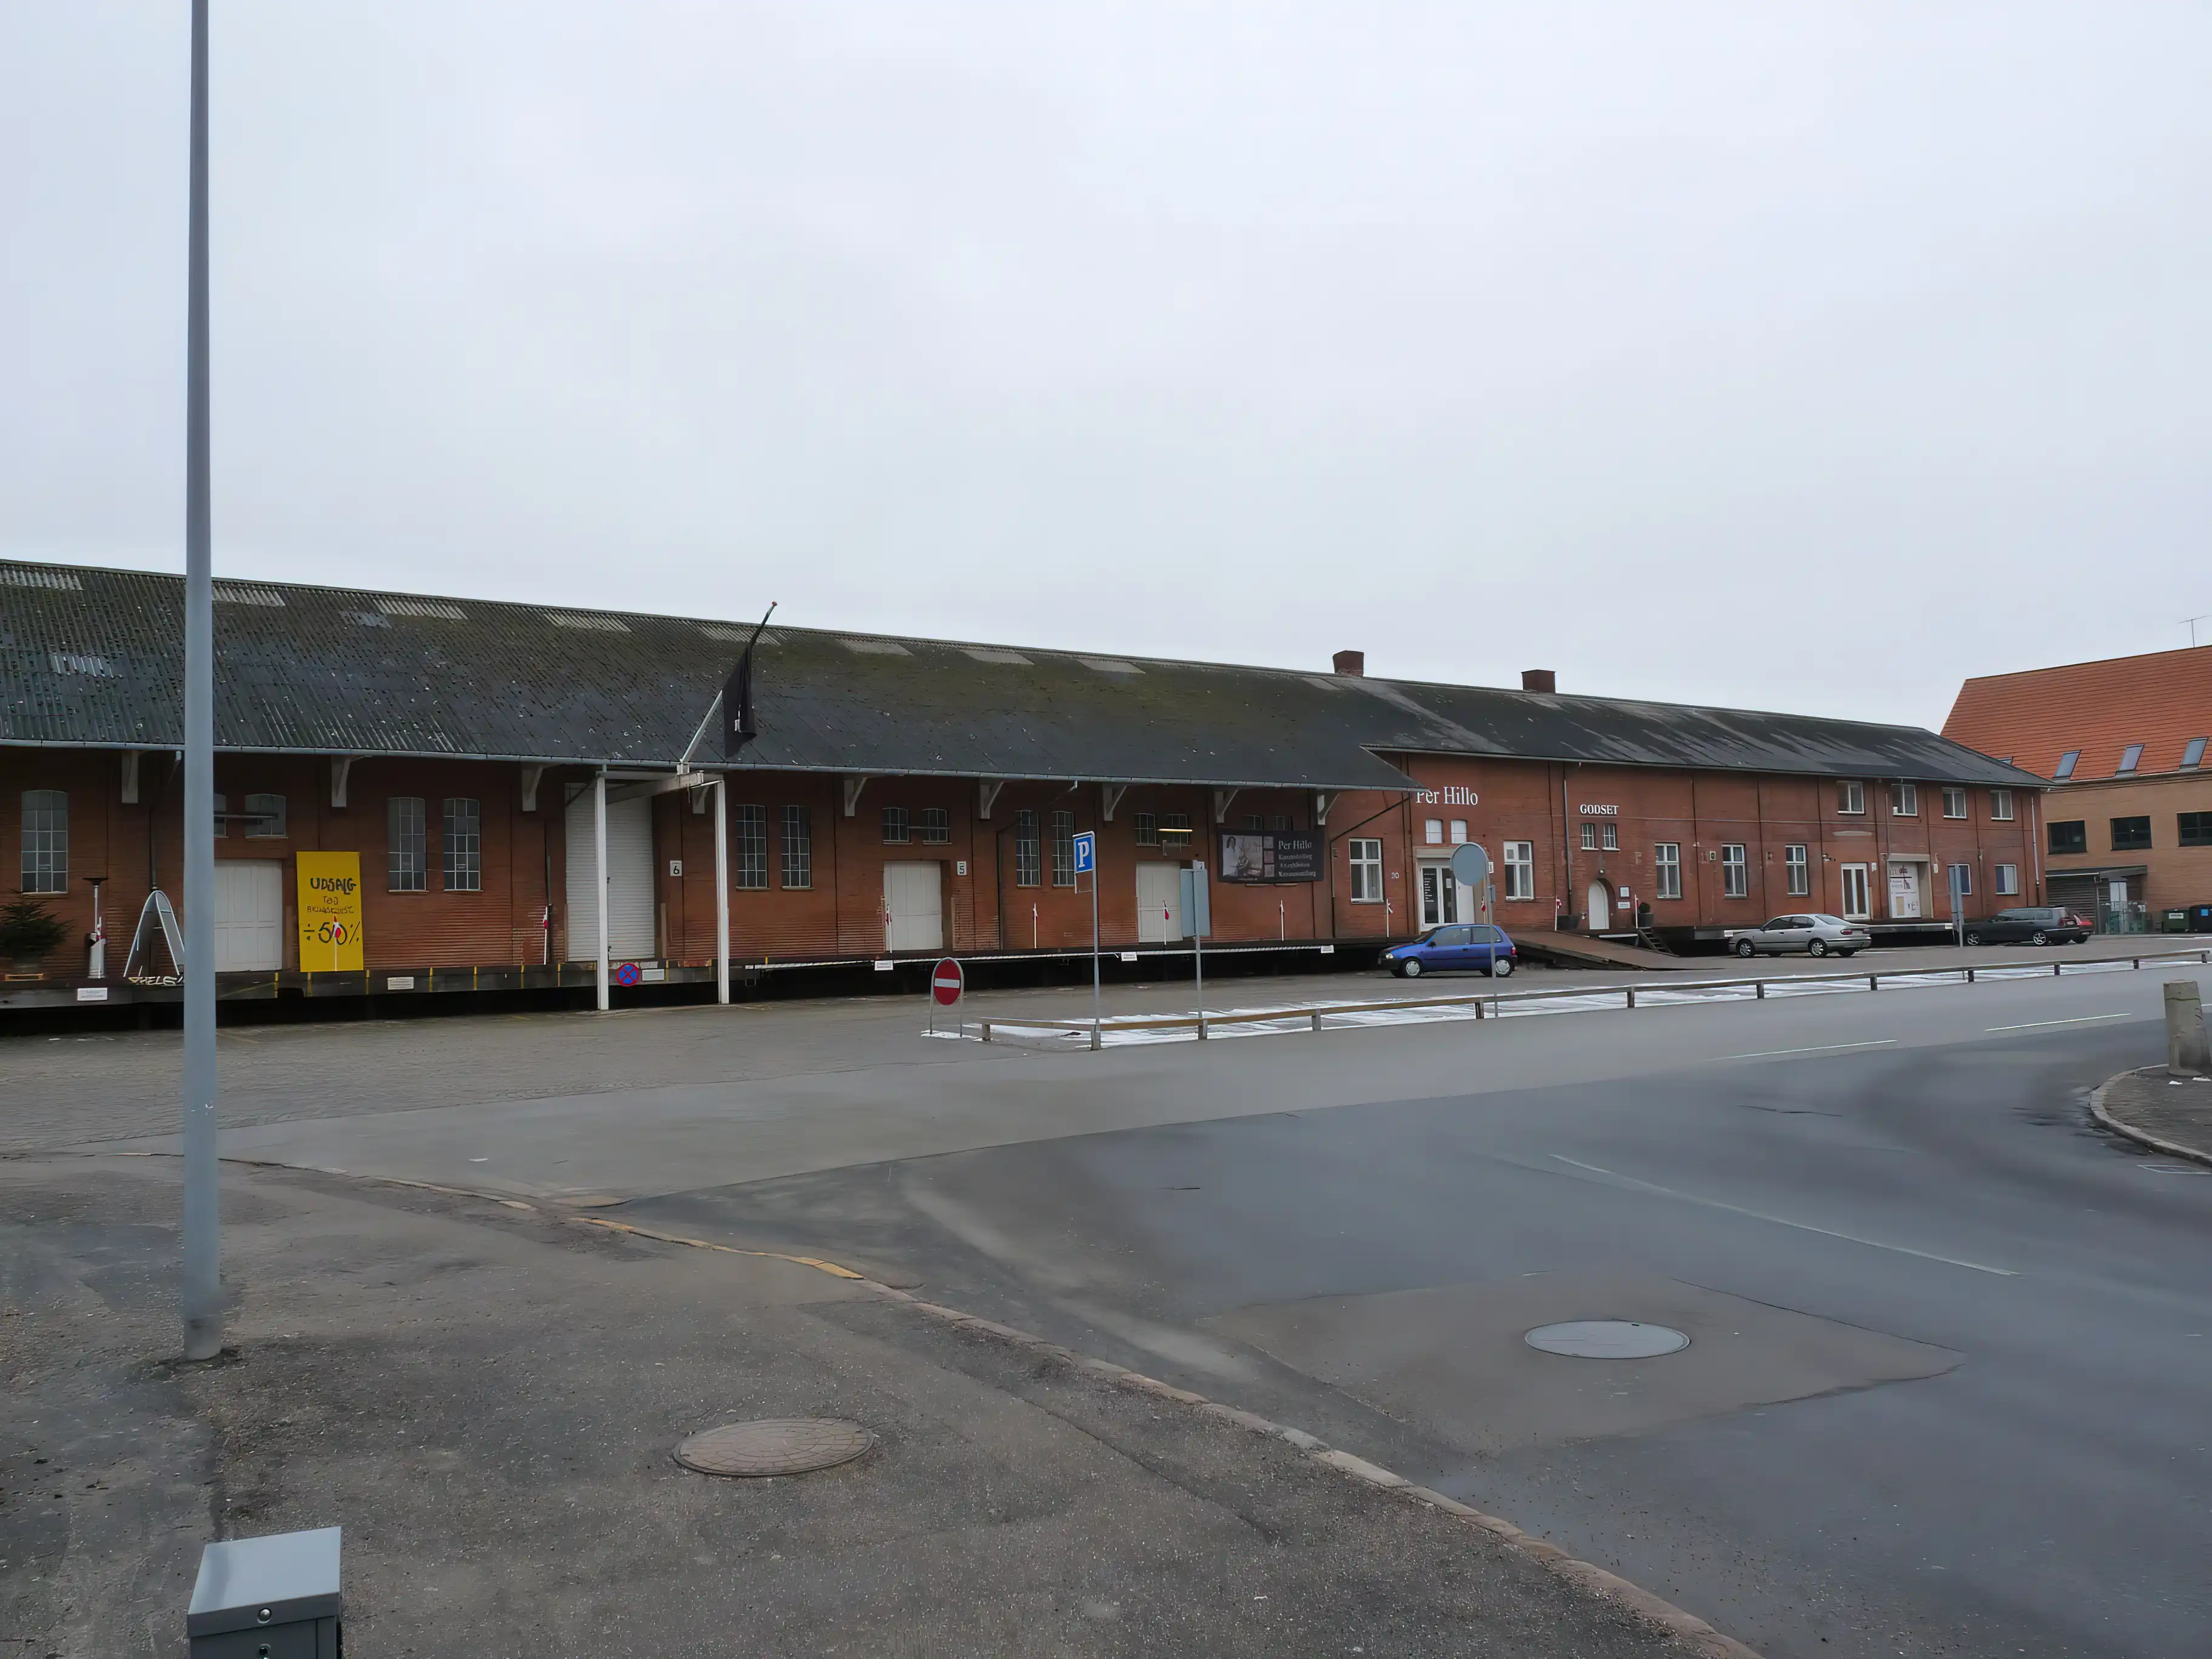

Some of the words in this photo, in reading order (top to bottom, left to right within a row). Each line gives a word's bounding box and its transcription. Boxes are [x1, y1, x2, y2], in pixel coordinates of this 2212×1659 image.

[1443, 786, 1478, 805] Hillo
[1580, 804, 1619, 815] GODSET
[1278, 840, 1291, 850] Per
[1293, 840, 1312, 850] Hillo
[1078, 841, 1090, 868] P
[674, 865, 680, 874] 6
[959, 865, 965, 874] 5
[310, 877, 357, 895] UDSALG
